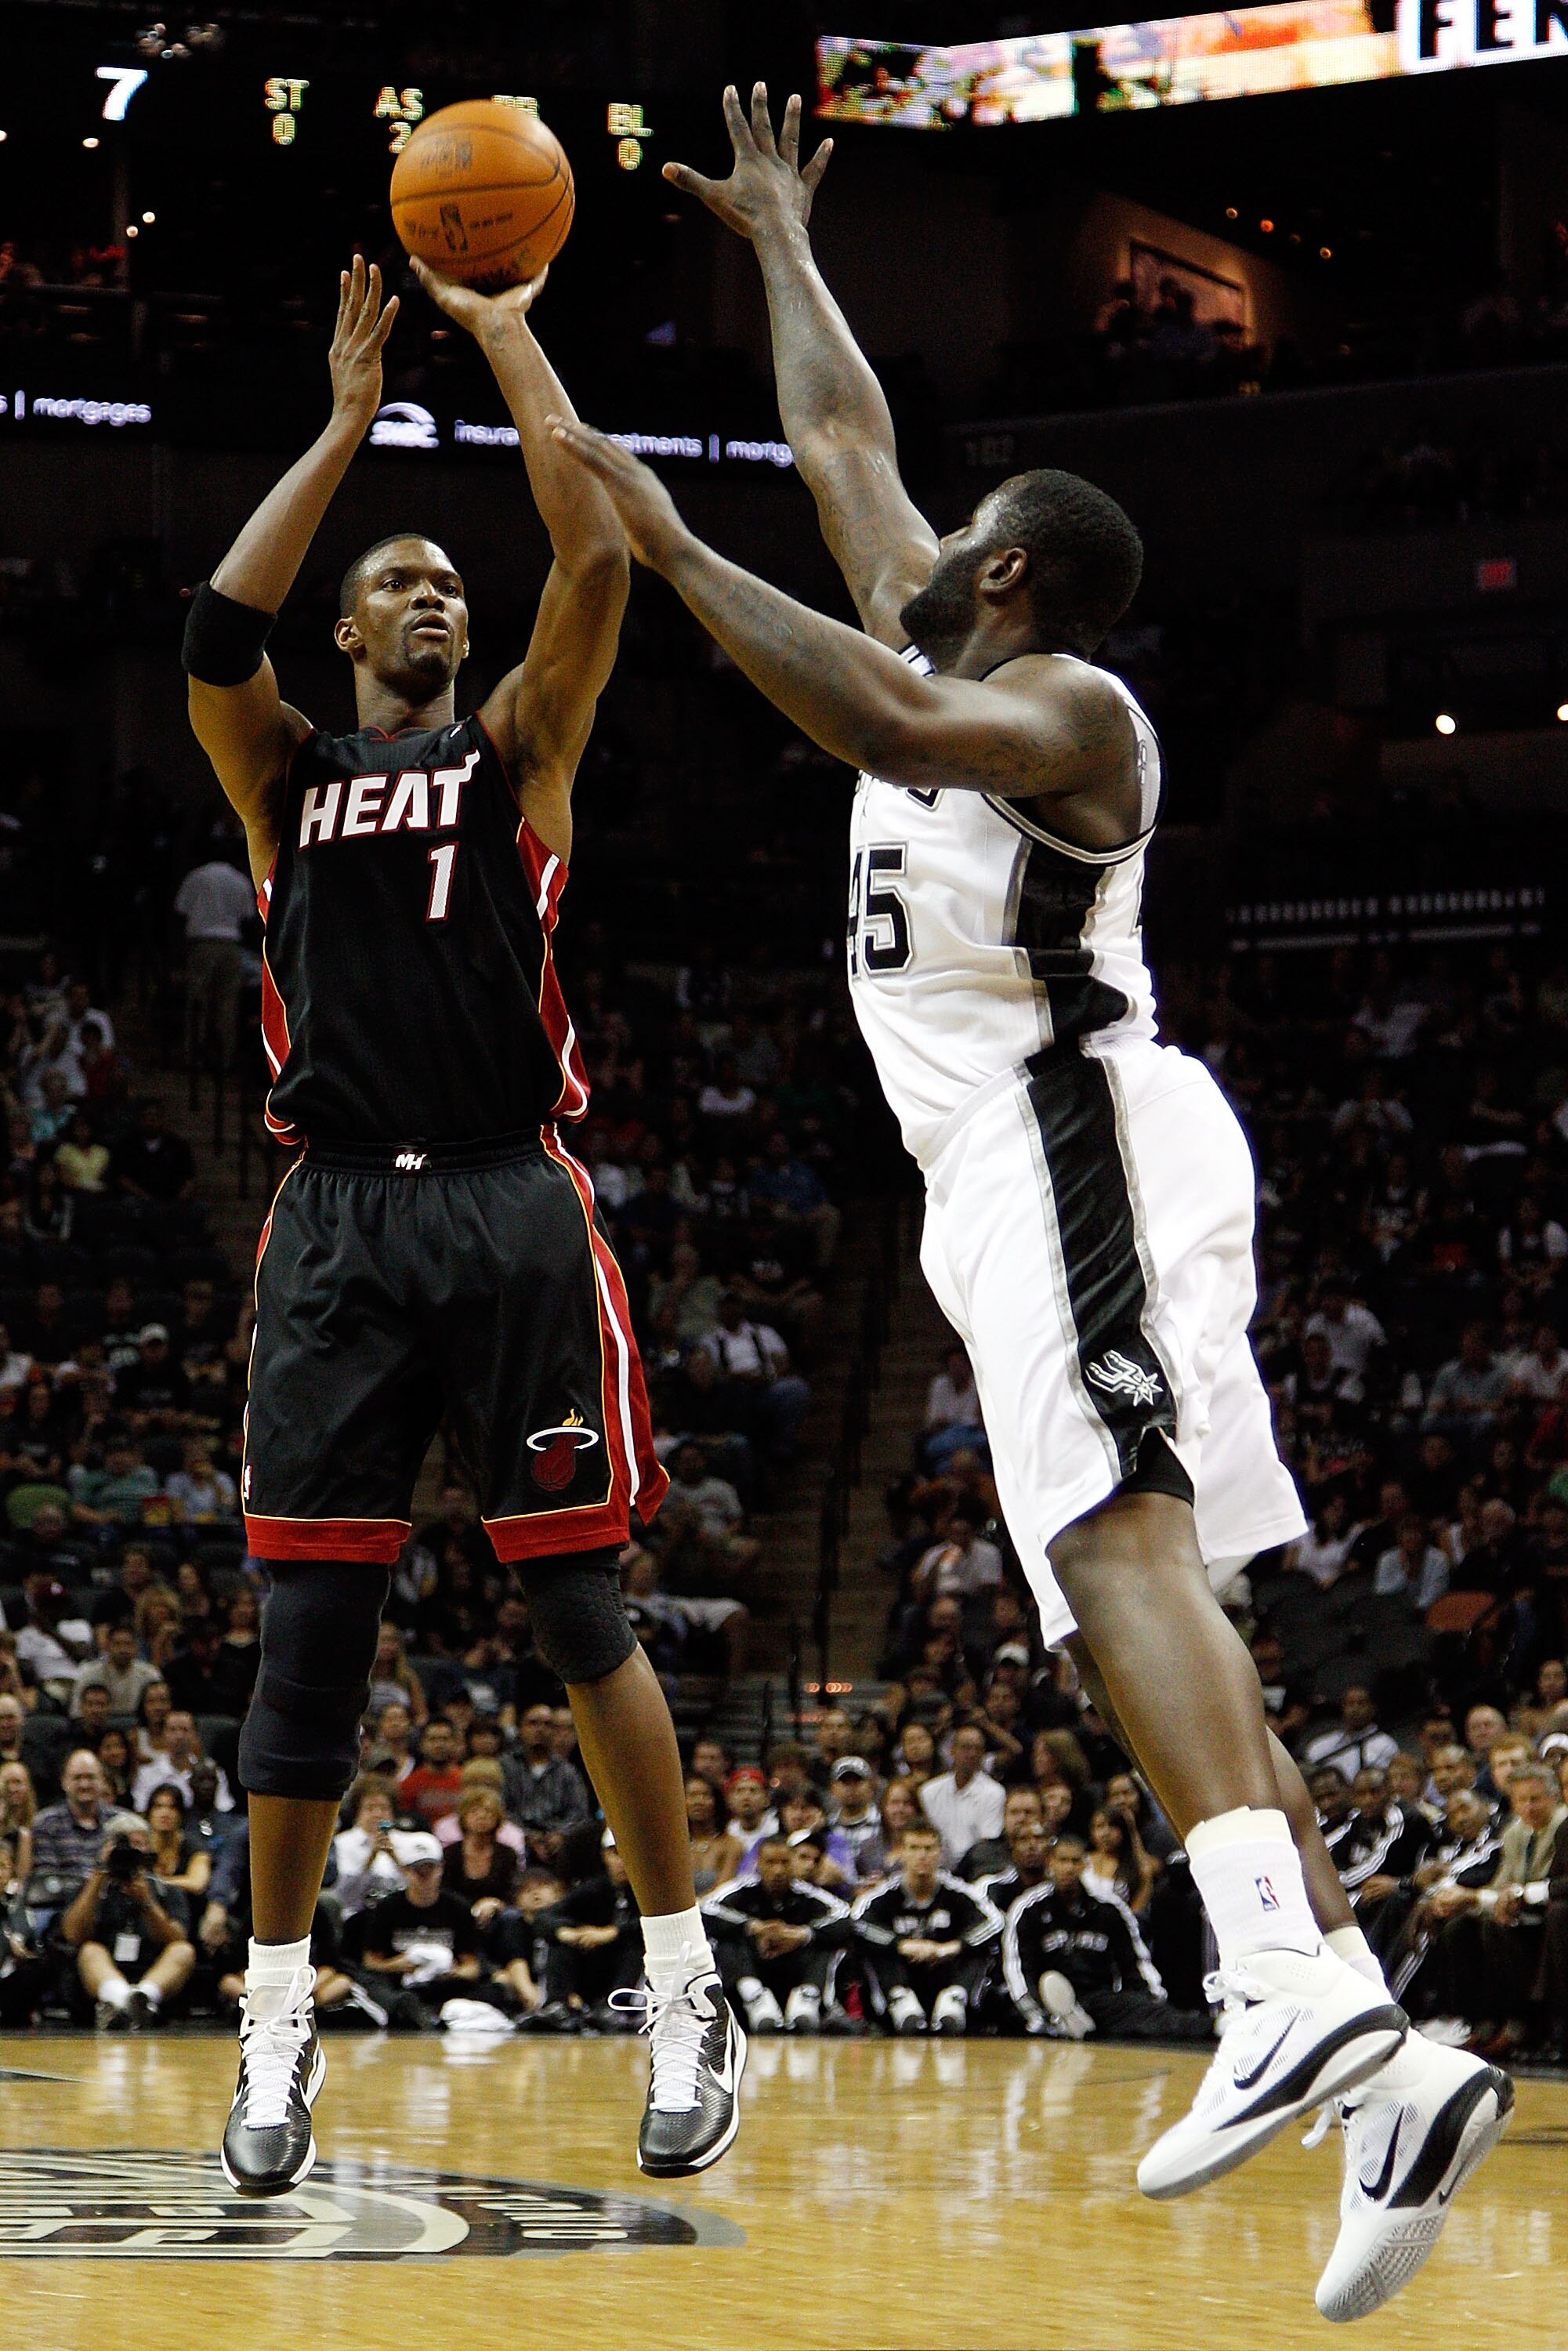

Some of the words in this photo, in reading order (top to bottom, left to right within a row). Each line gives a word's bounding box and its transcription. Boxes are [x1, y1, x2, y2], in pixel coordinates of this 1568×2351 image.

[96, 67, 147, 121] 7
[265, 78, 310, 110] ST
[374, 86, 424, 120] AS
[273, 113, 296, 145] 0
[389, 121, 411, 154] 2
[617, 138, 643, 170] 0
[33, 397, 151, 427] mortgages
[299, 748, 481, 849] HEAT
[427, 842, 459, 922] 1
